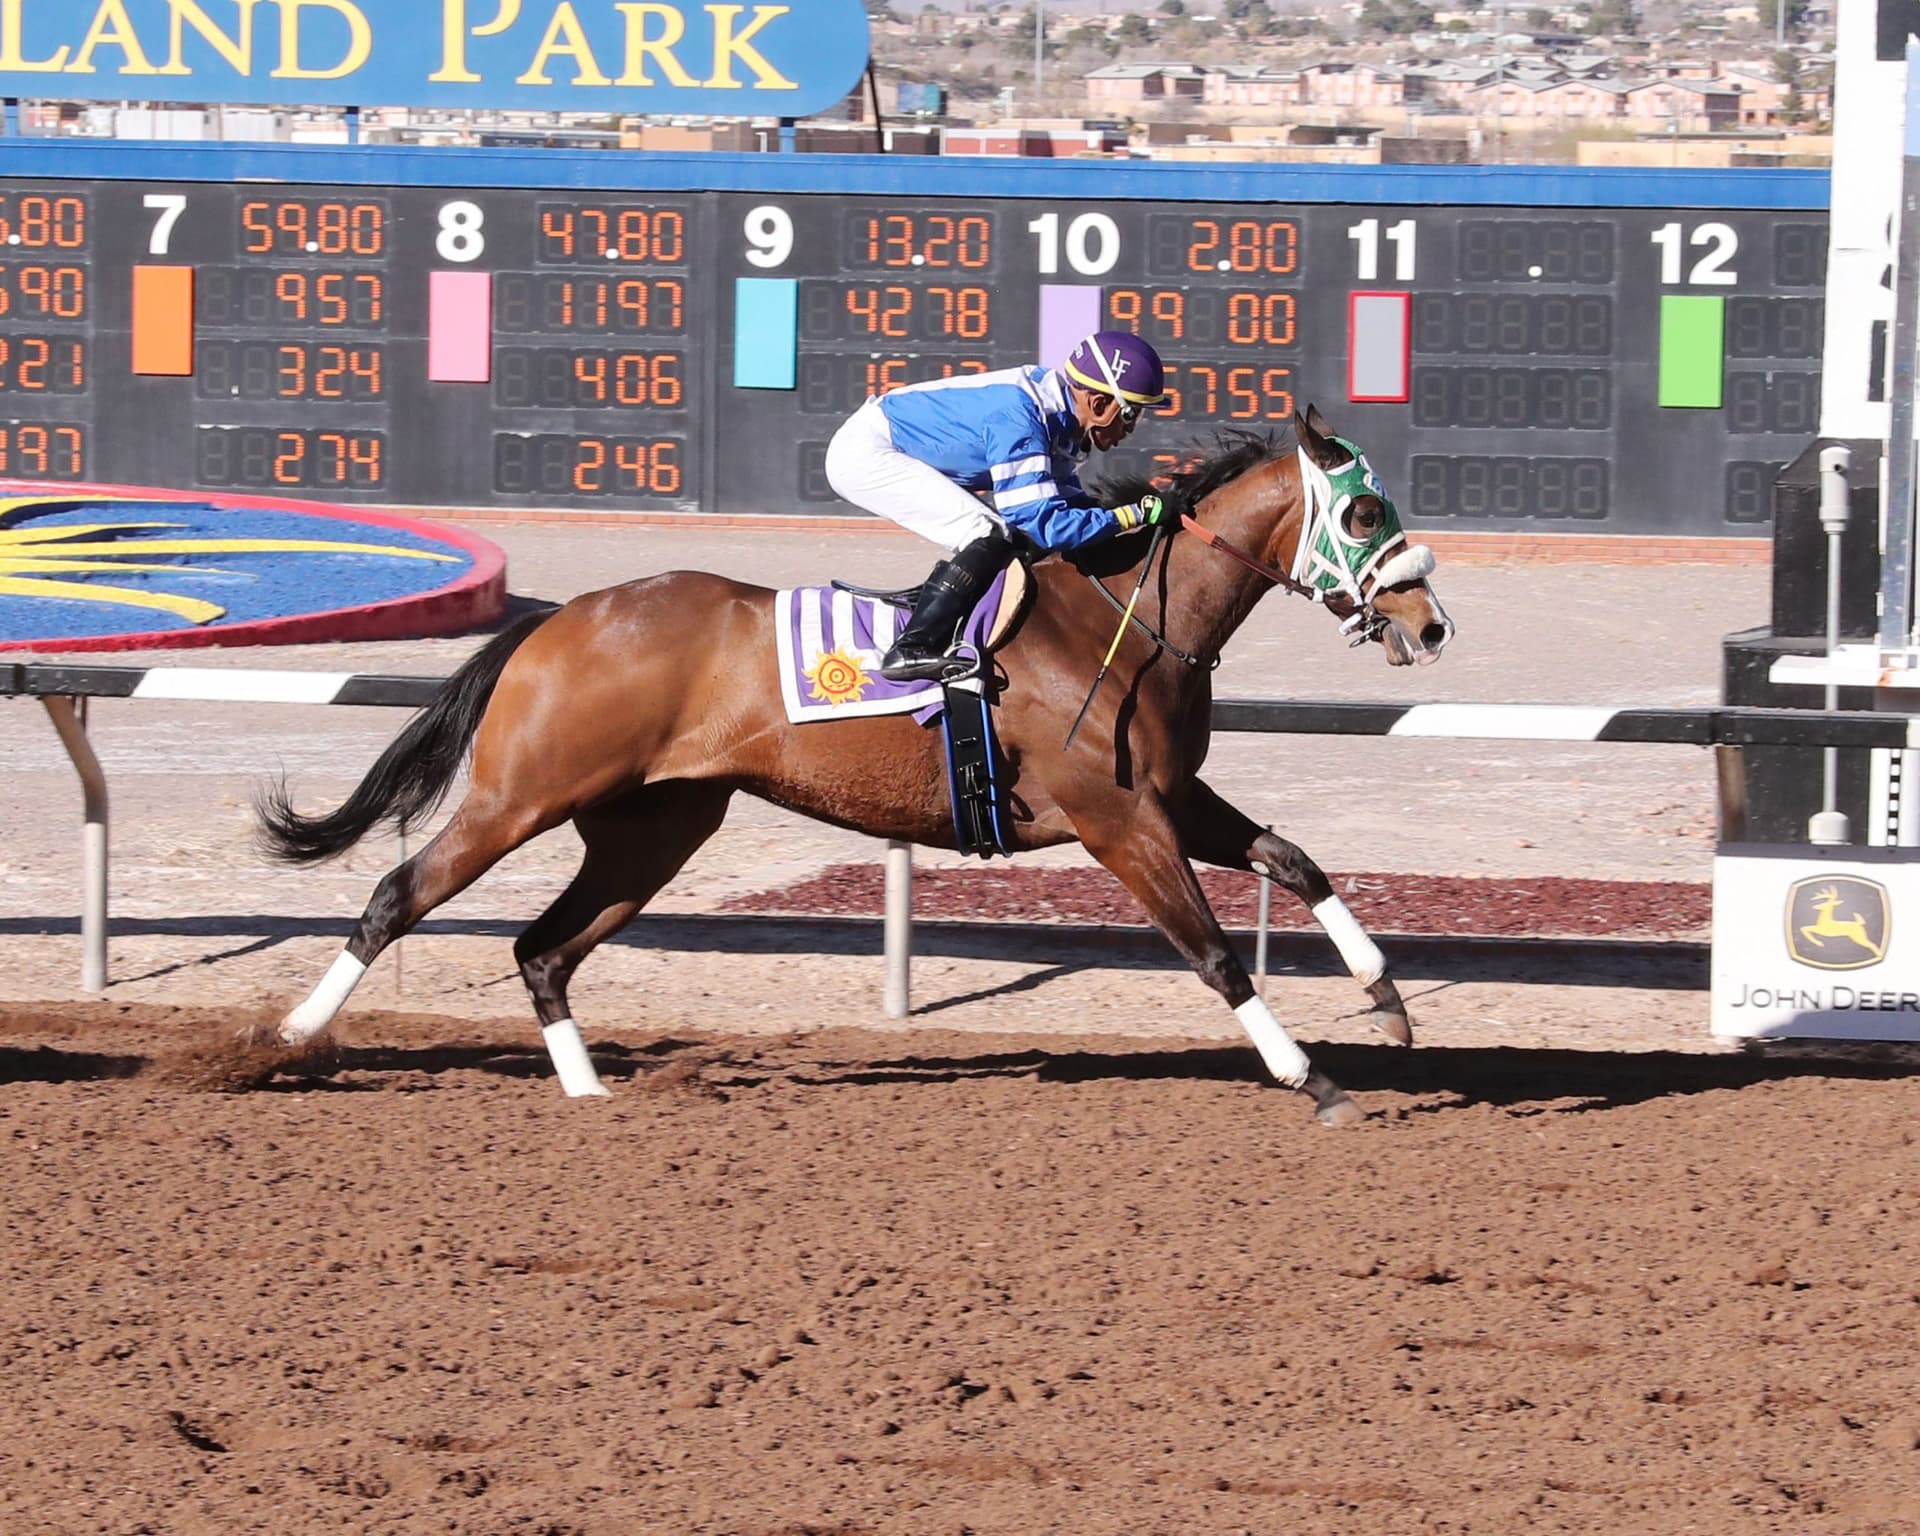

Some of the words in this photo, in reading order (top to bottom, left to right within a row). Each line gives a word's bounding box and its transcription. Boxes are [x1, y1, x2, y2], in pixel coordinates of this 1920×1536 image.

[0, 0, 372, 79] LAND
[428, 0, 799, 90] PARK
[143, 194, 187, 255] 7
[242, 203, 383, 254] 59.80
[435, 200, 485, 263] 8
[542, 209, 684, 261] 47.80
[743, 205, 794, 268] 9
[868, 215, 990, 268] 13.20
[1028, 212, 1121, 276] 10
[1187, 220, 1297, 273] 2.80
[1348, 218, 1417, 281] 11
[1651, 222, 1739, 285] 12
[276, 273, 382, 324] 957
[562, 280, 683, 328] 1197
[281, 346, 381, 397] 324
[575, 354, 681, 405] 406
[573, 440, 681, 493] 246
[1730, 984, 1821, 1010] JOHN
[1831, 986, 1920, 1012] DEER
